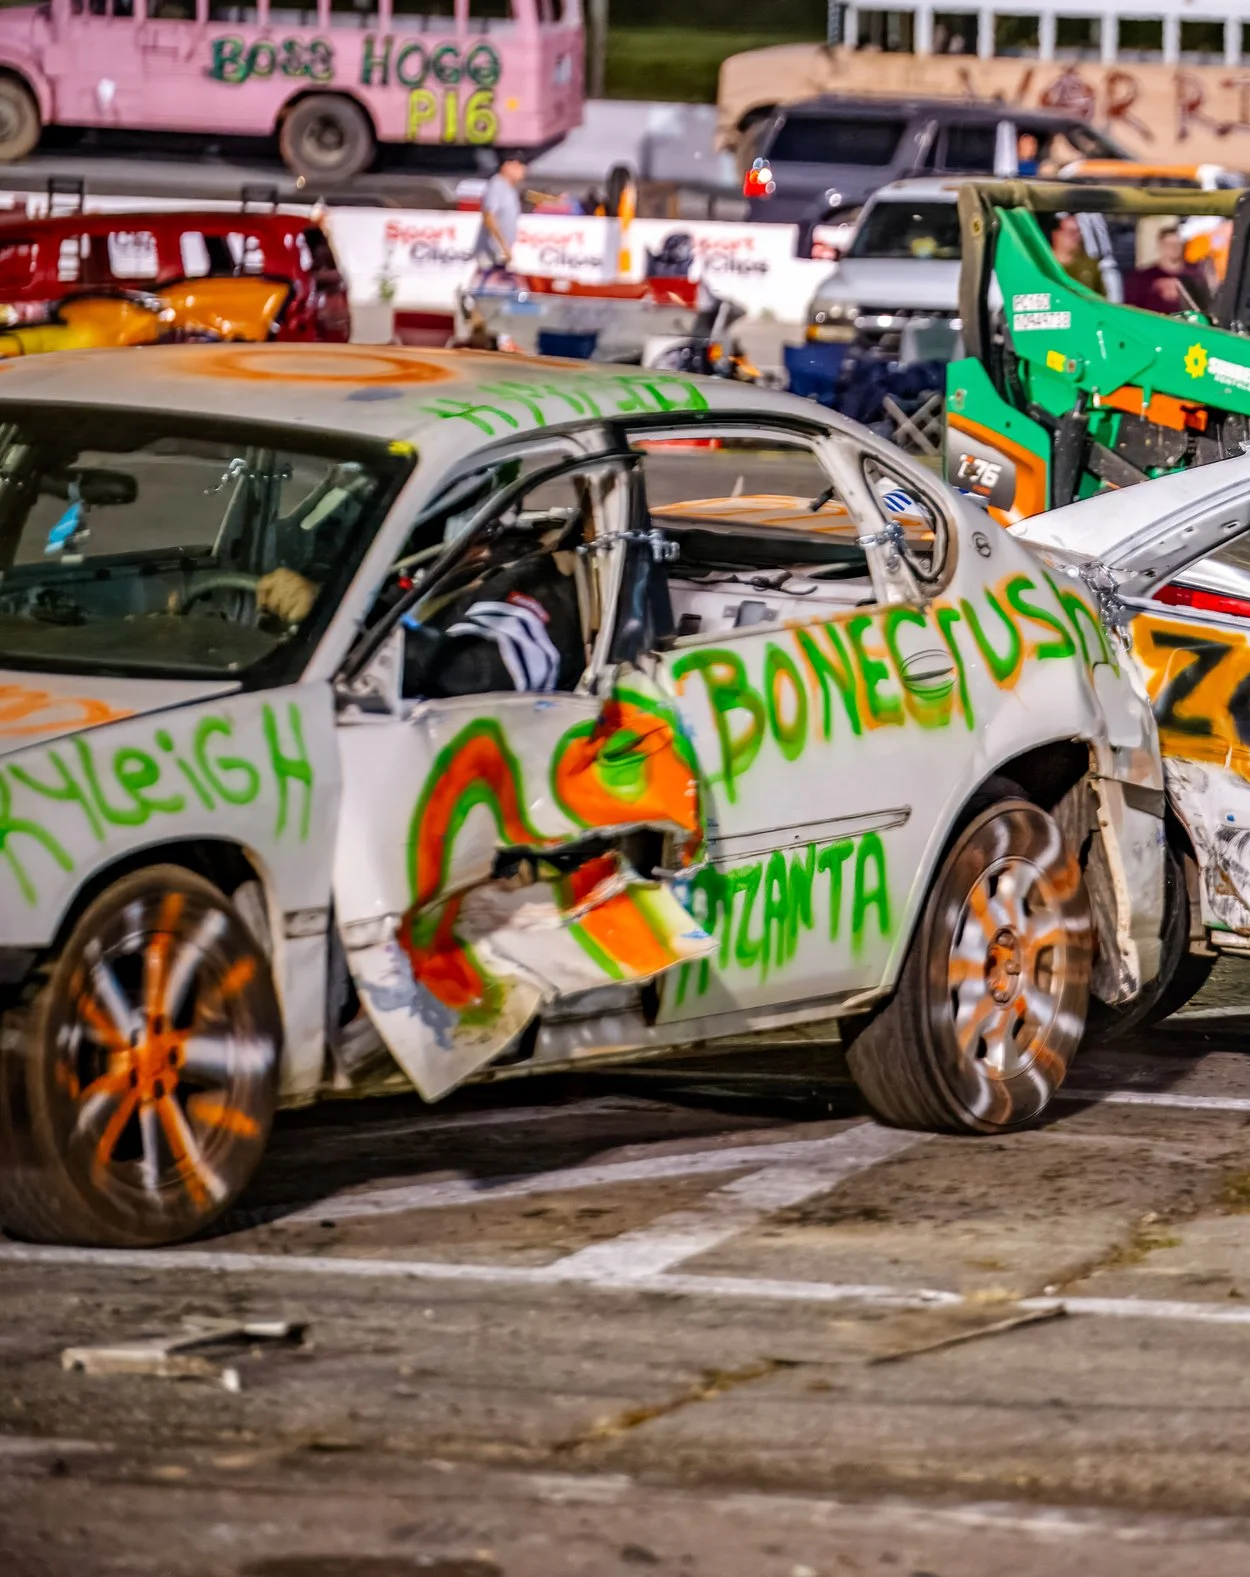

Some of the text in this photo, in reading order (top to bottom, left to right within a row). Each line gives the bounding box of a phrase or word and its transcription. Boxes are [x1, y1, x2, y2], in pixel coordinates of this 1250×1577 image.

[361, 32, 501, 88] HOGG
[406, 88, 499, 145] P16
[385, 219, 456, 247] Sport
[410, 240, 474, 264] Clips
